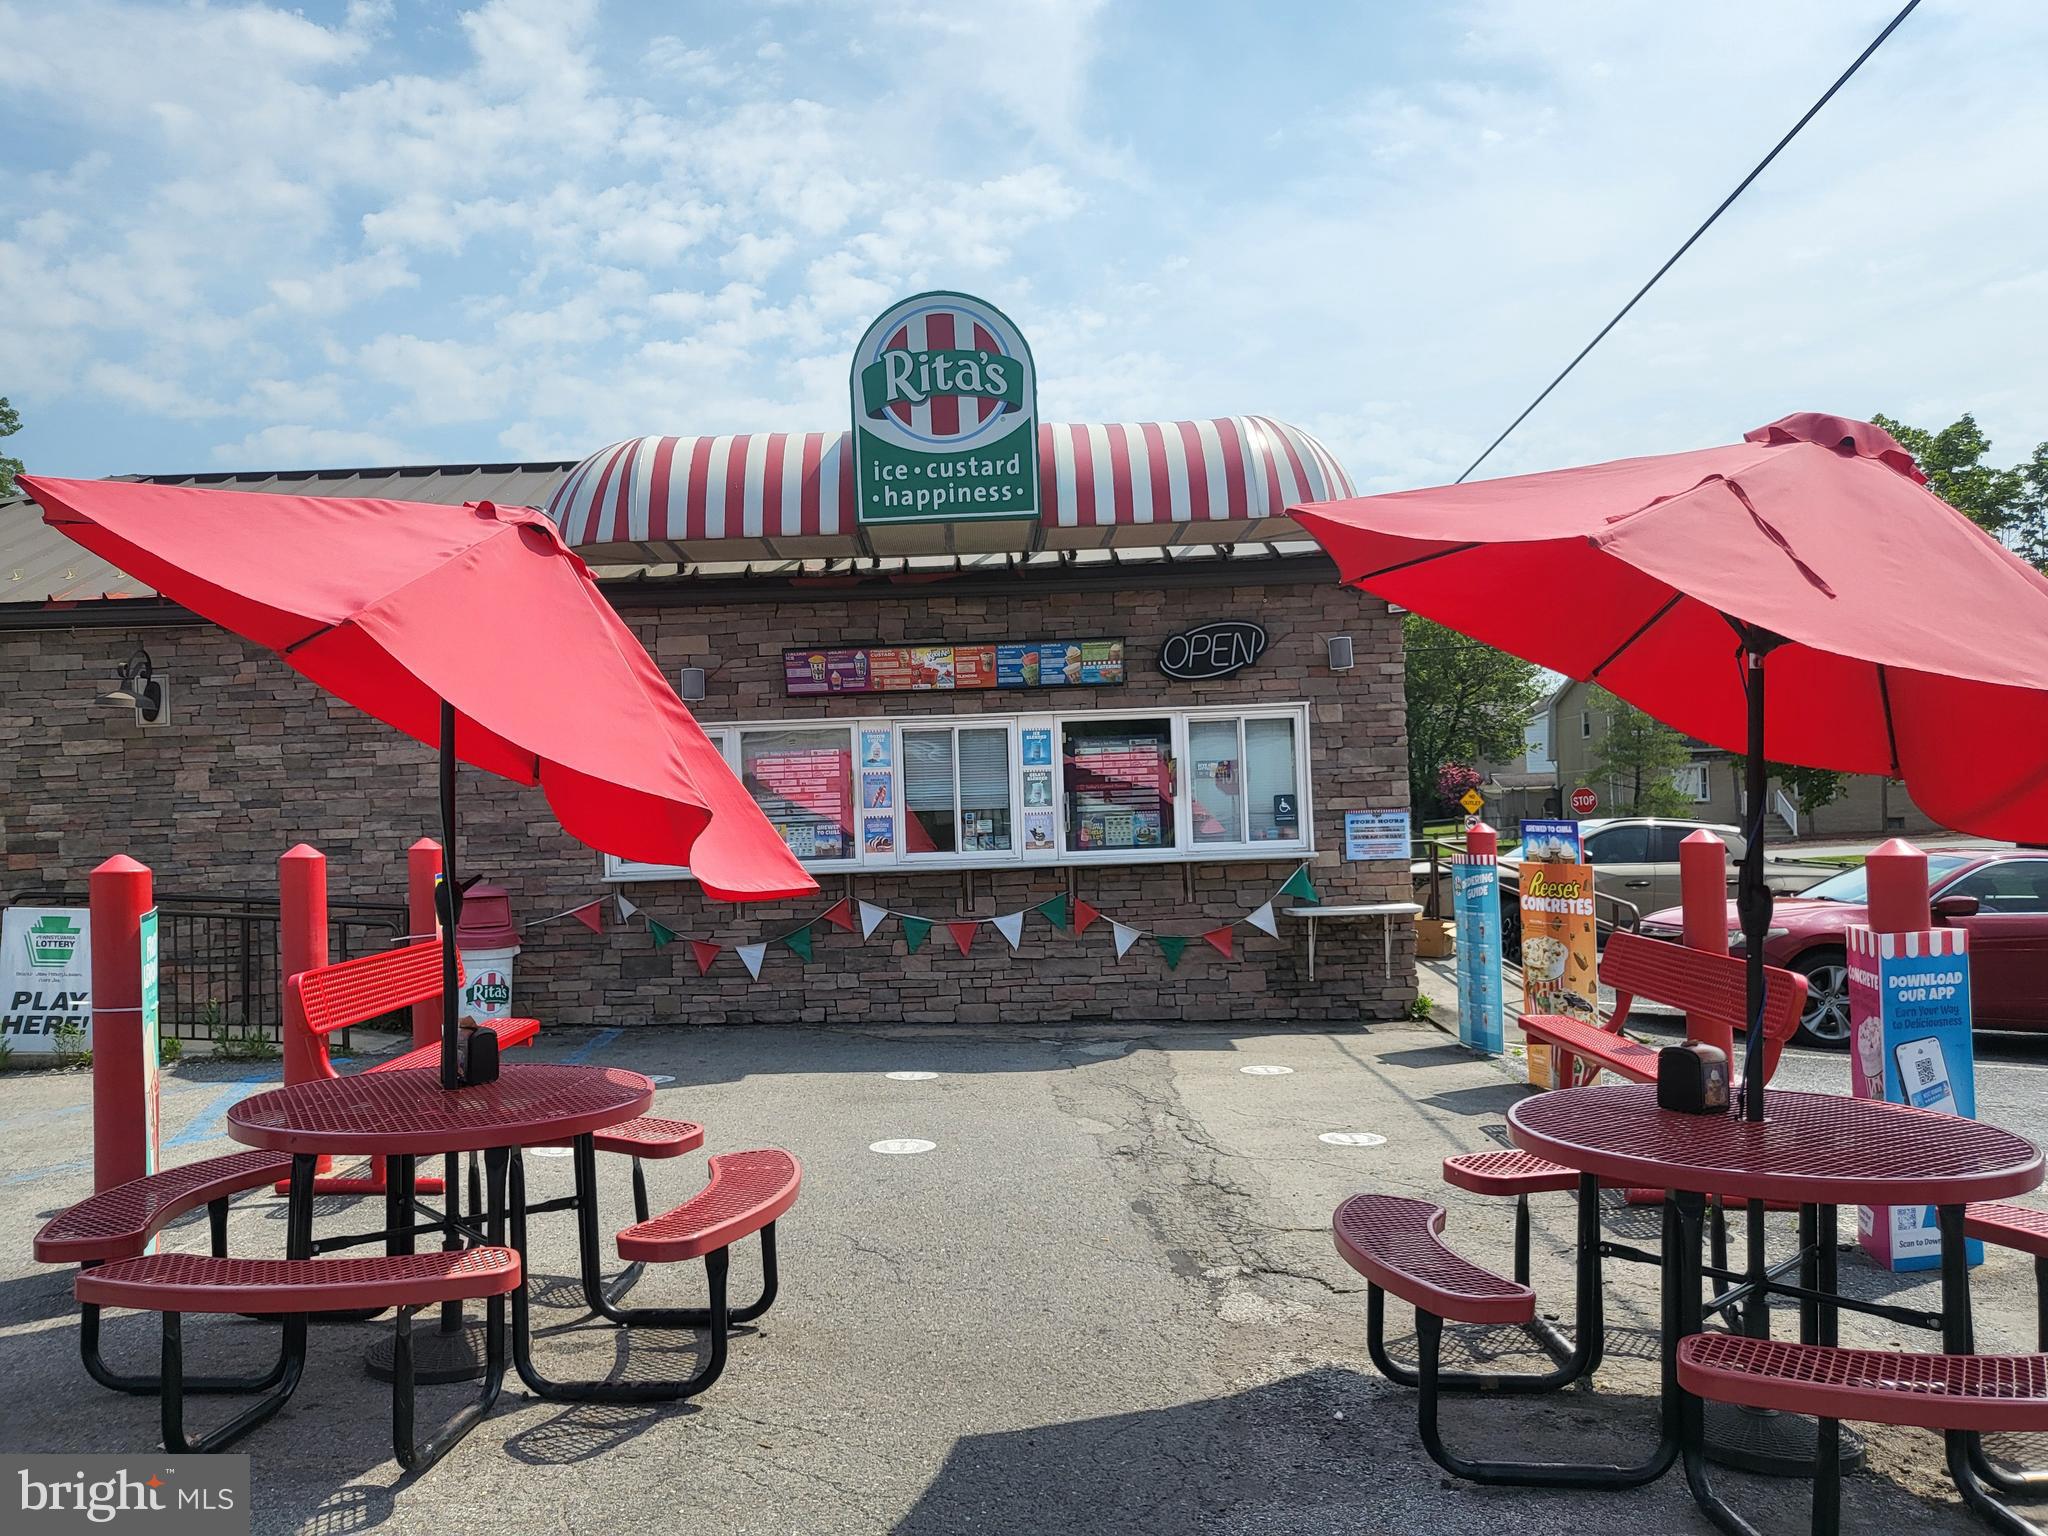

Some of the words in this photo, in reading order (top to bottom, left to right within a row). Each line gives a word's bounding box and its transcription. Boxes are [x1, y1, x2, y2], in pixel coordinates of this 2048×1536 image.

[883, 350, 1008, 402] Rita's
[873, 460, 908, 481] ice
[926, 452, 1020, 478] custard
[884, 482, 1012, 512] happiness
[1163, 631, 1256, 669] OPEN
[1573, 796, 1595, 807] STOP
[1461, 872, 1494, 889] ORDERING
[1528, 870, 1580, 899] Reese's
[1467, 885, 1489, 900] GUIDE
[1520, 894, 1594, 916] CONCRETES
[35, 940, 76, 948] LOTTERY
[1888, 971, 1963, 989] DOWNLOAD
[10, 991, 89, 1011] PLAY
[473, 984, 508, 1001] Rita's
[1898, 988, 1926, 1002] OUR
[1928, 986, 1956, 1000] APP
[1894, 1006, 1917, 1018] Earn
[1918, 1006, 1938, 1018] Your
[1941, 1004, 1959, 1016] Way
[1892, 1019, 1903, 1030] to
[1904, 1017, 1963, 1030] Deliciousness
[1898, 1240, 1915, 1249] Scan
